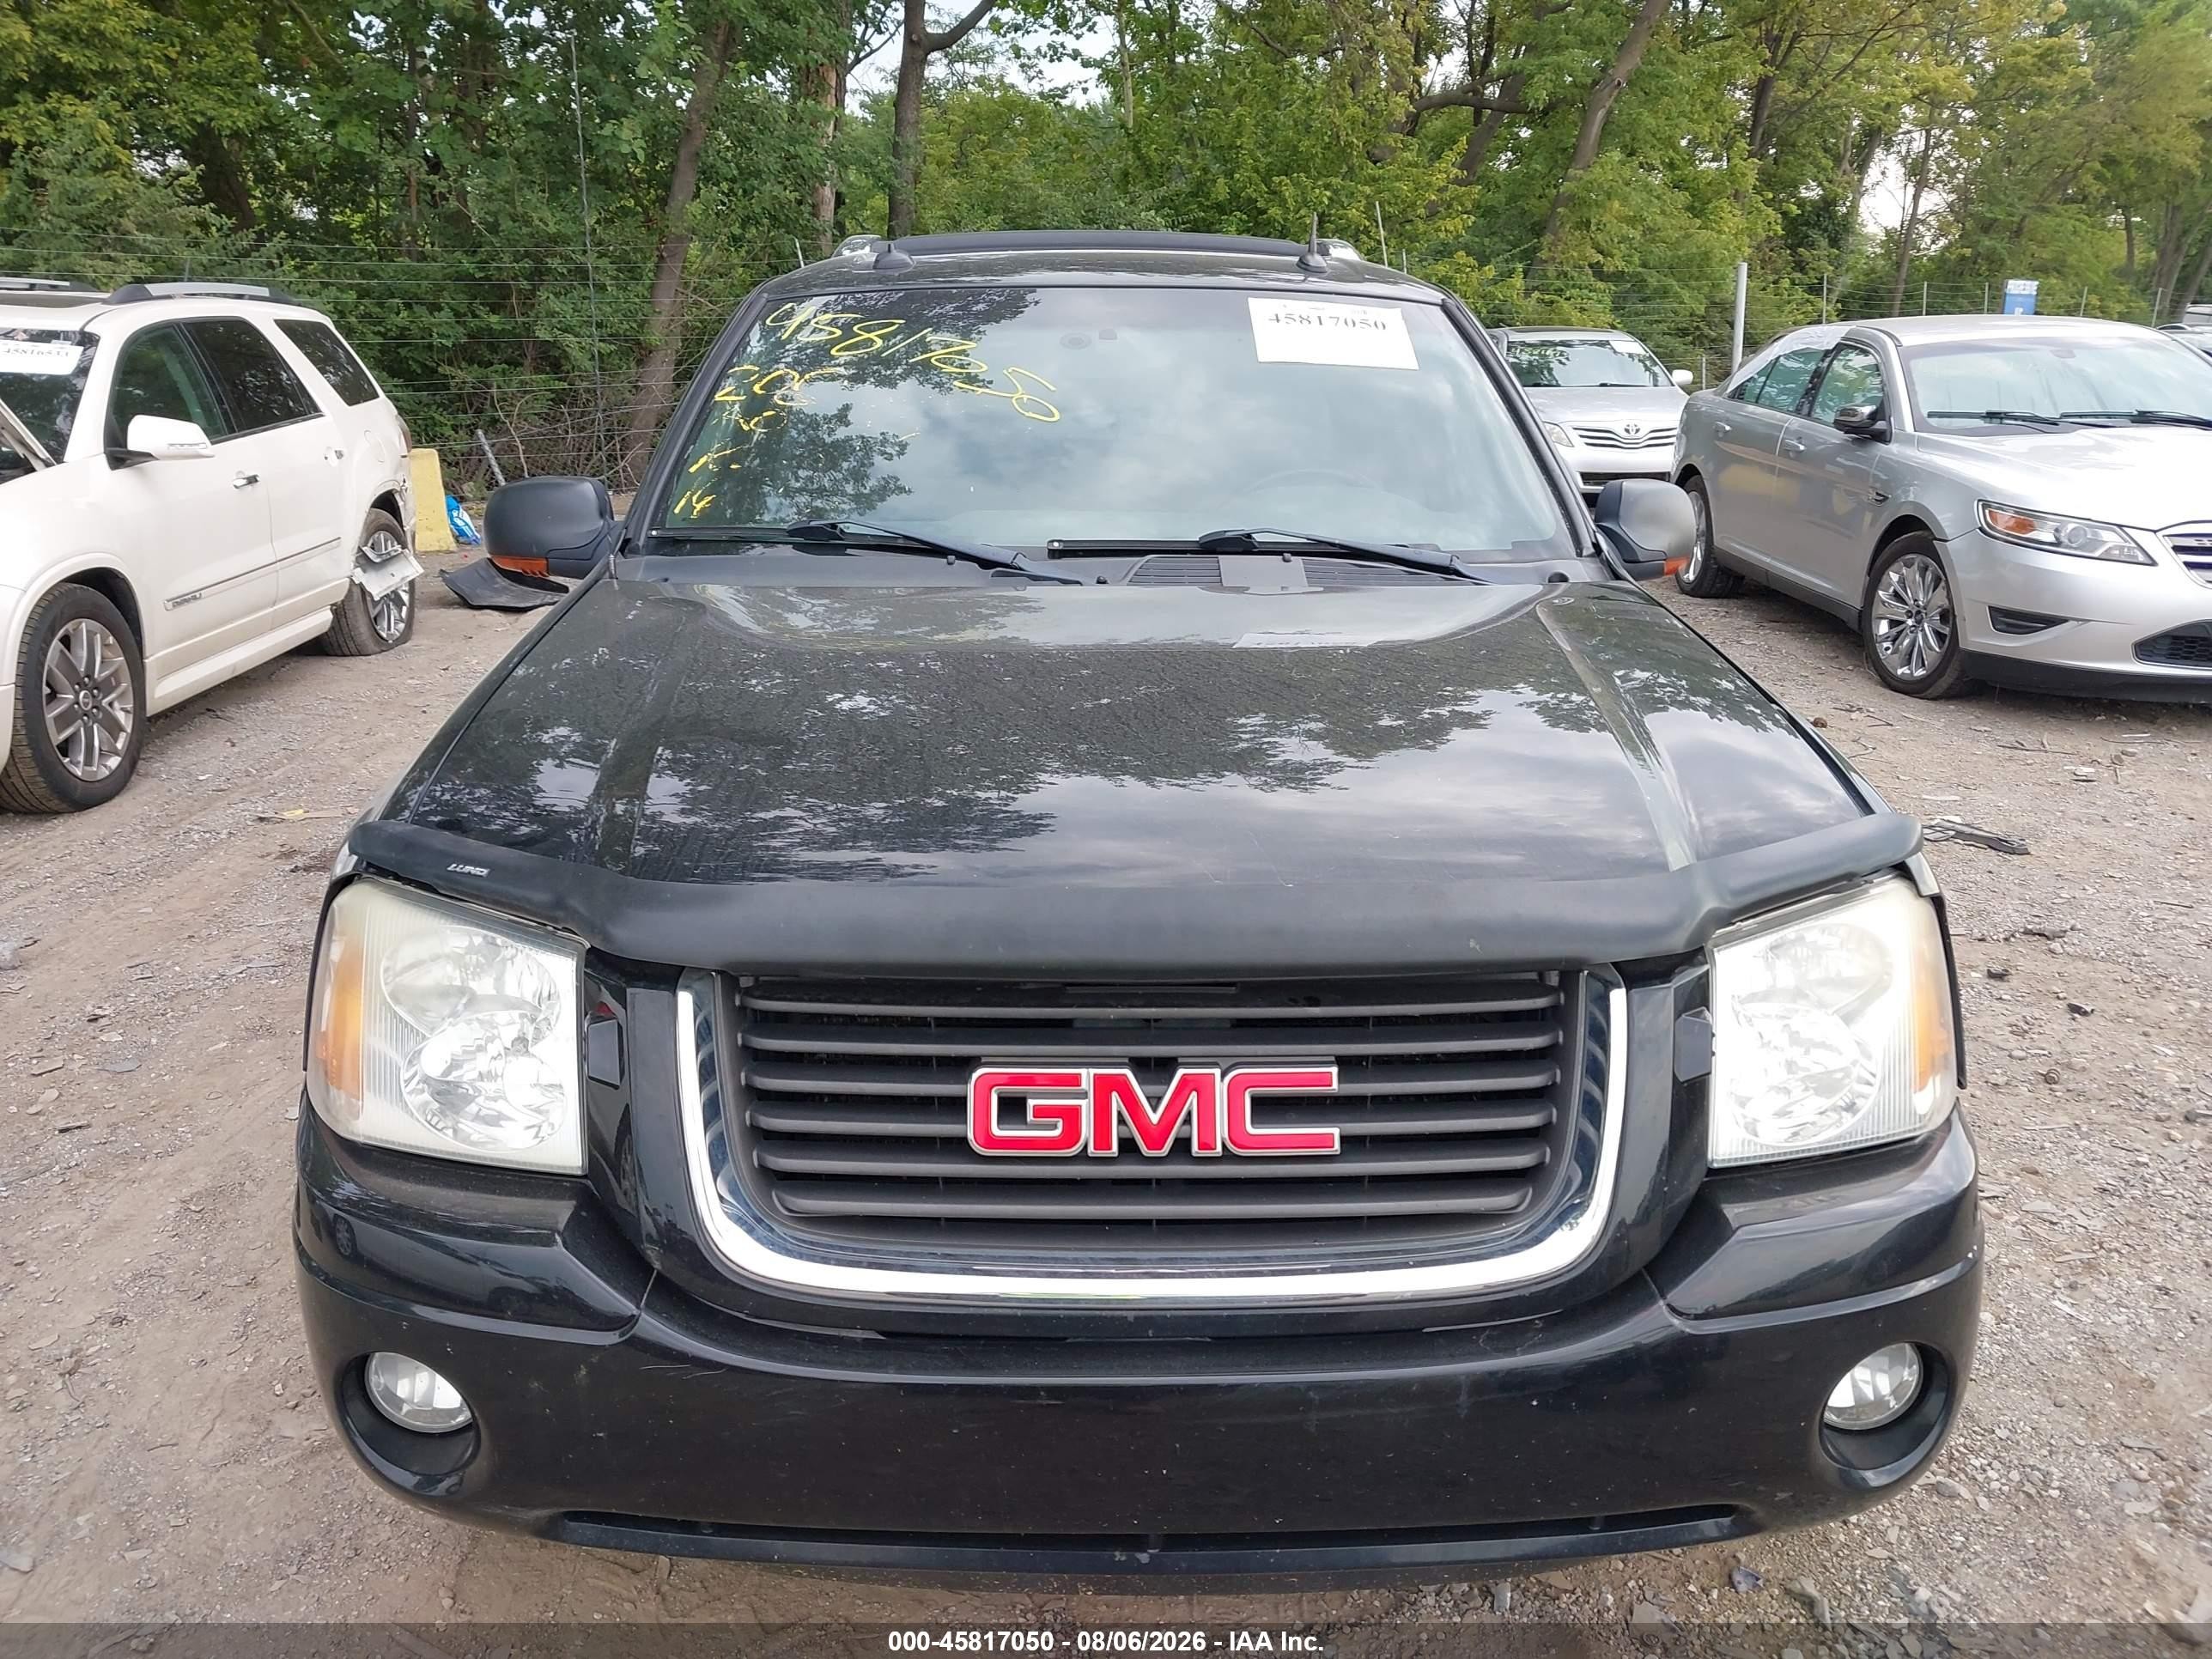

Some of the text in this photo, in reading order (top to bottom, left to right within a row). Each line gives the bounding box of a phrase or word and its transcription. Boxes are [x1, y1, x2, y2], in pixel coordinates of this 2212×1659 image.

[1267, 313, 1388, 331] 45817050
[447, 863, 490, 878] LUND
[968, 1066, 1340, 1157] GMC
